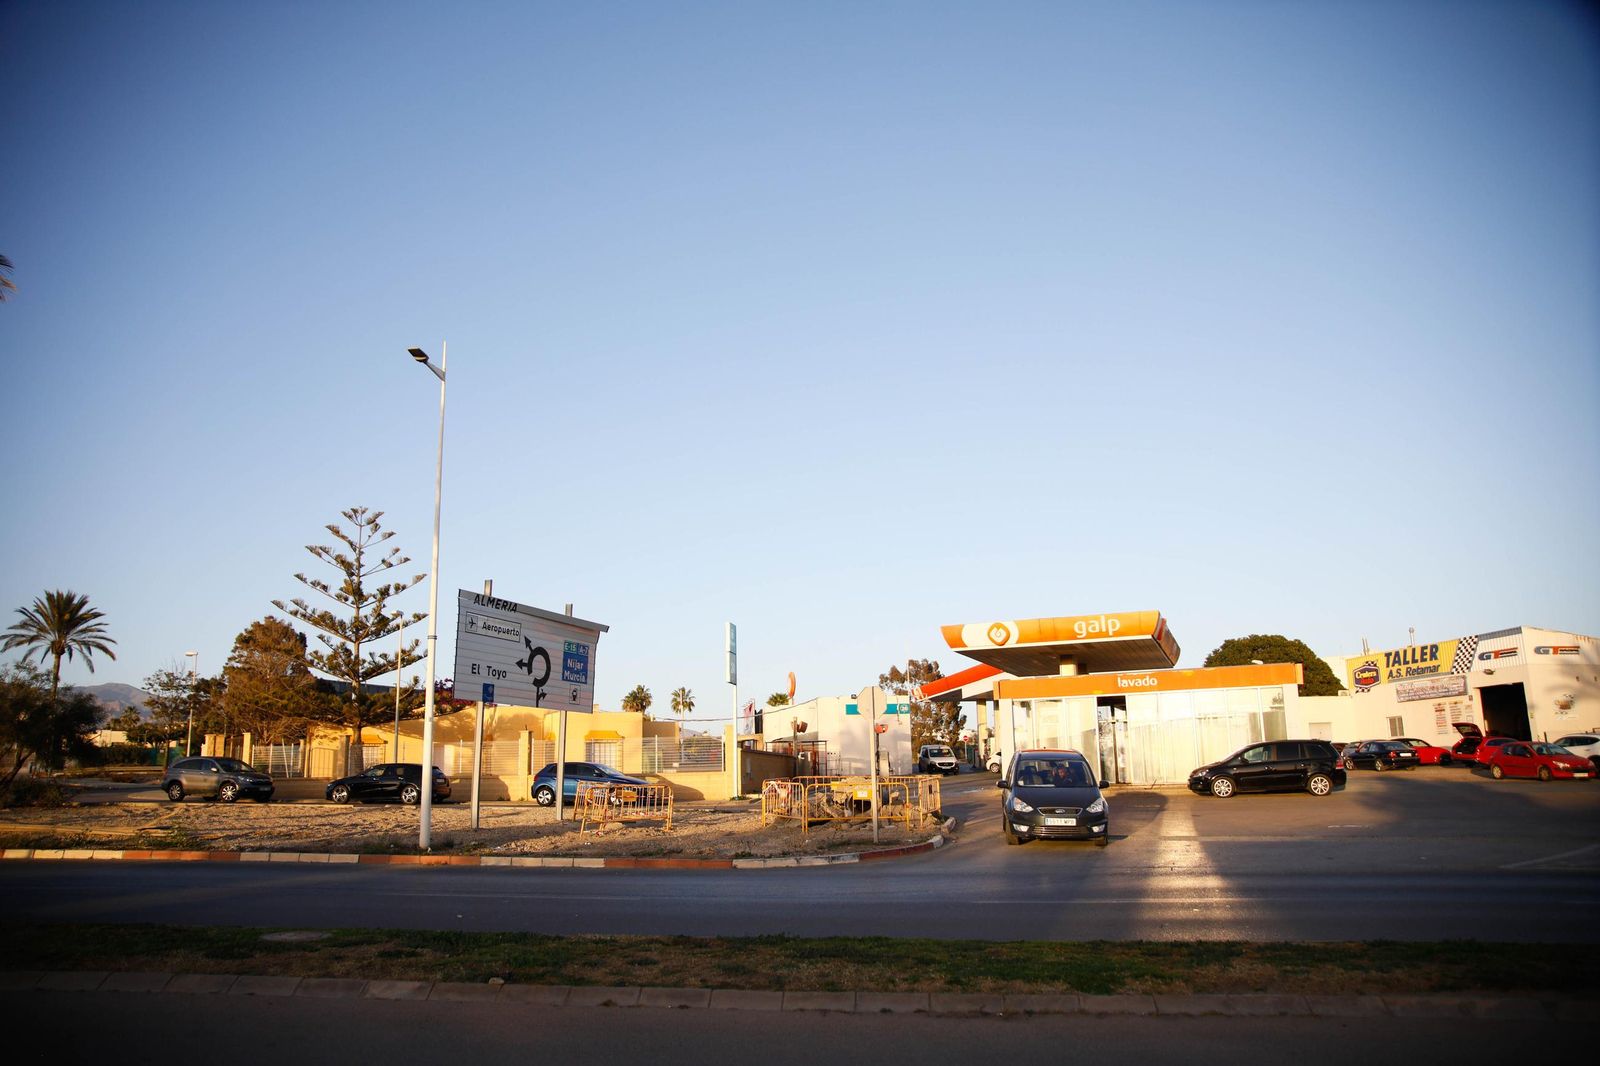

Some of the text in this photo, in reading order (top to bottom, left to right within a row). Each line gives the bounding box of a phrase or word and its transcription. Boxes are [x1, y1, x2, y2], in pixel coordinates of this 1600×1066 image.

[474, 594, 518, 613] ALMERIA
[482, 621, 520, 637] Aeropuerto
[1073, 615, 1121, 637] galp
[564, 643, 577, 652] E-15
[1385, 644, 1439, 668] TALLER
[471, 663, 507, 680] El Toyo
[564, 671, 586, 682] Murcia
[1387, 664, 1440, 679] A.S. Retamar
[1118, 677, 1157, 687] lavado
